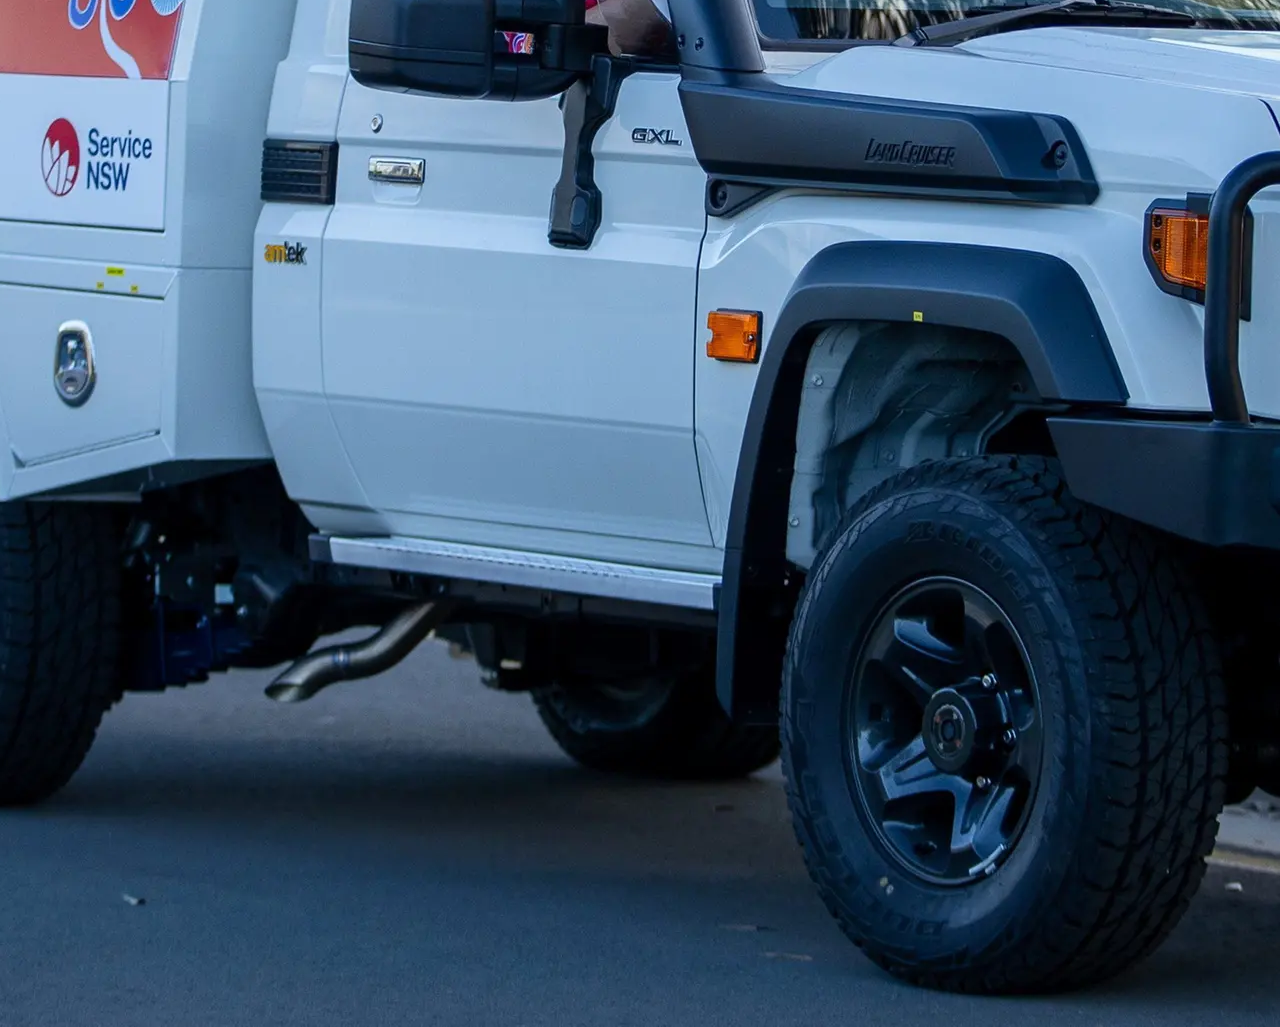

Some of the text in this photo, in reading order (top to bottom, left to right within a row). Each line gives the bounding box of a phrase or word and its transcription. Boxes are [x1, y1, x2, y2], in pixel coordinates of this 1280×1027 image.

[88, 127, 152, 159] Service
[631, 127, 682, 146] GXL
[87, 161, 130, 191] NSW
